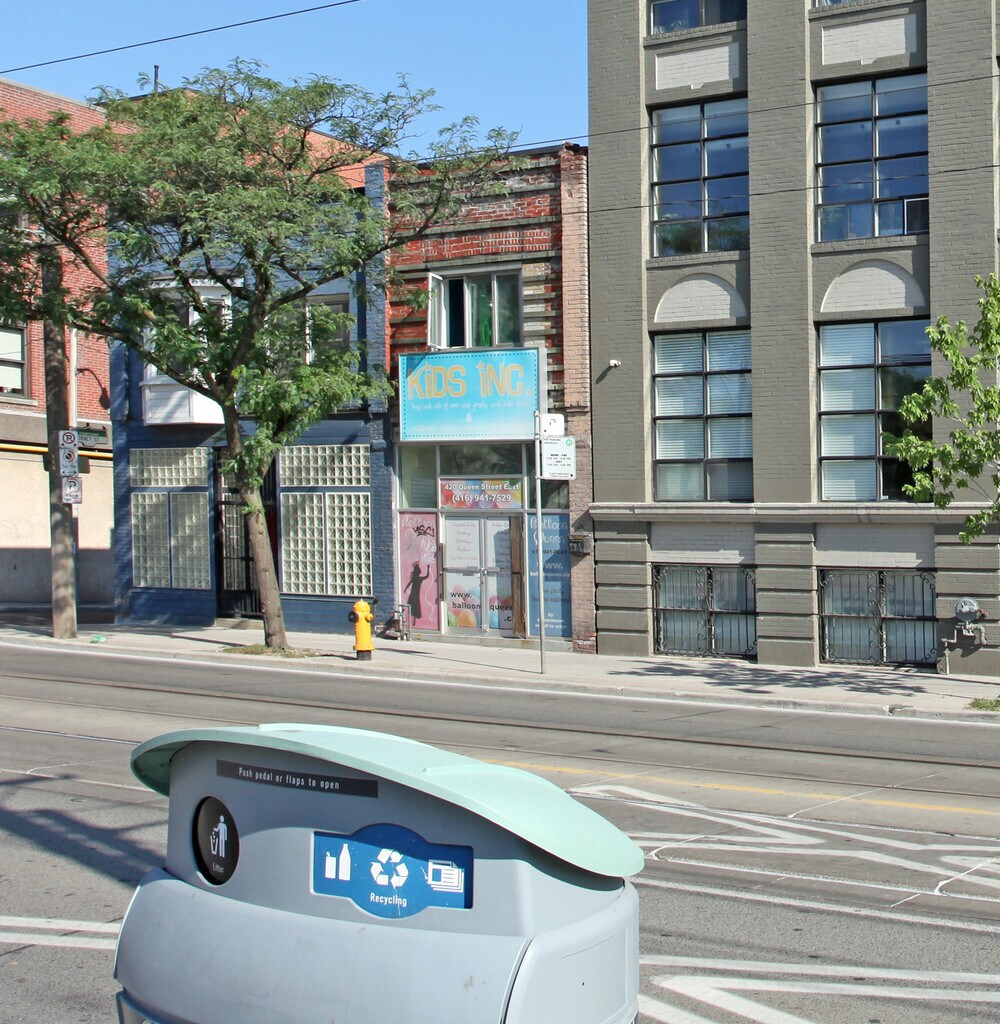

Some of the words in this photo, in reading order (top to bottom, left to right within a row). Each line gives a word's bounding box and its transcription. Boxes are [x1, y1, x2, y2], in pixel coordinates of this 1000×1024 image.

[458, 483, 480, 491] Queen
[452, 494, 473, 504] (416)
[475, 494, 512, 502] 941-7529
[450, 591, 472, 599] www.
[452, 602, 480, 610] balloon
[238, 767, 253, 777] Push
[255, 771, 273, 781] pedal
[286, 775, 305, 786] flaps
[308, 778, 316, 787] to
[320, 781, 340, 790] open
[213, 862, 225, 873] Litter
[370, 892, 407, 907] Recycling
